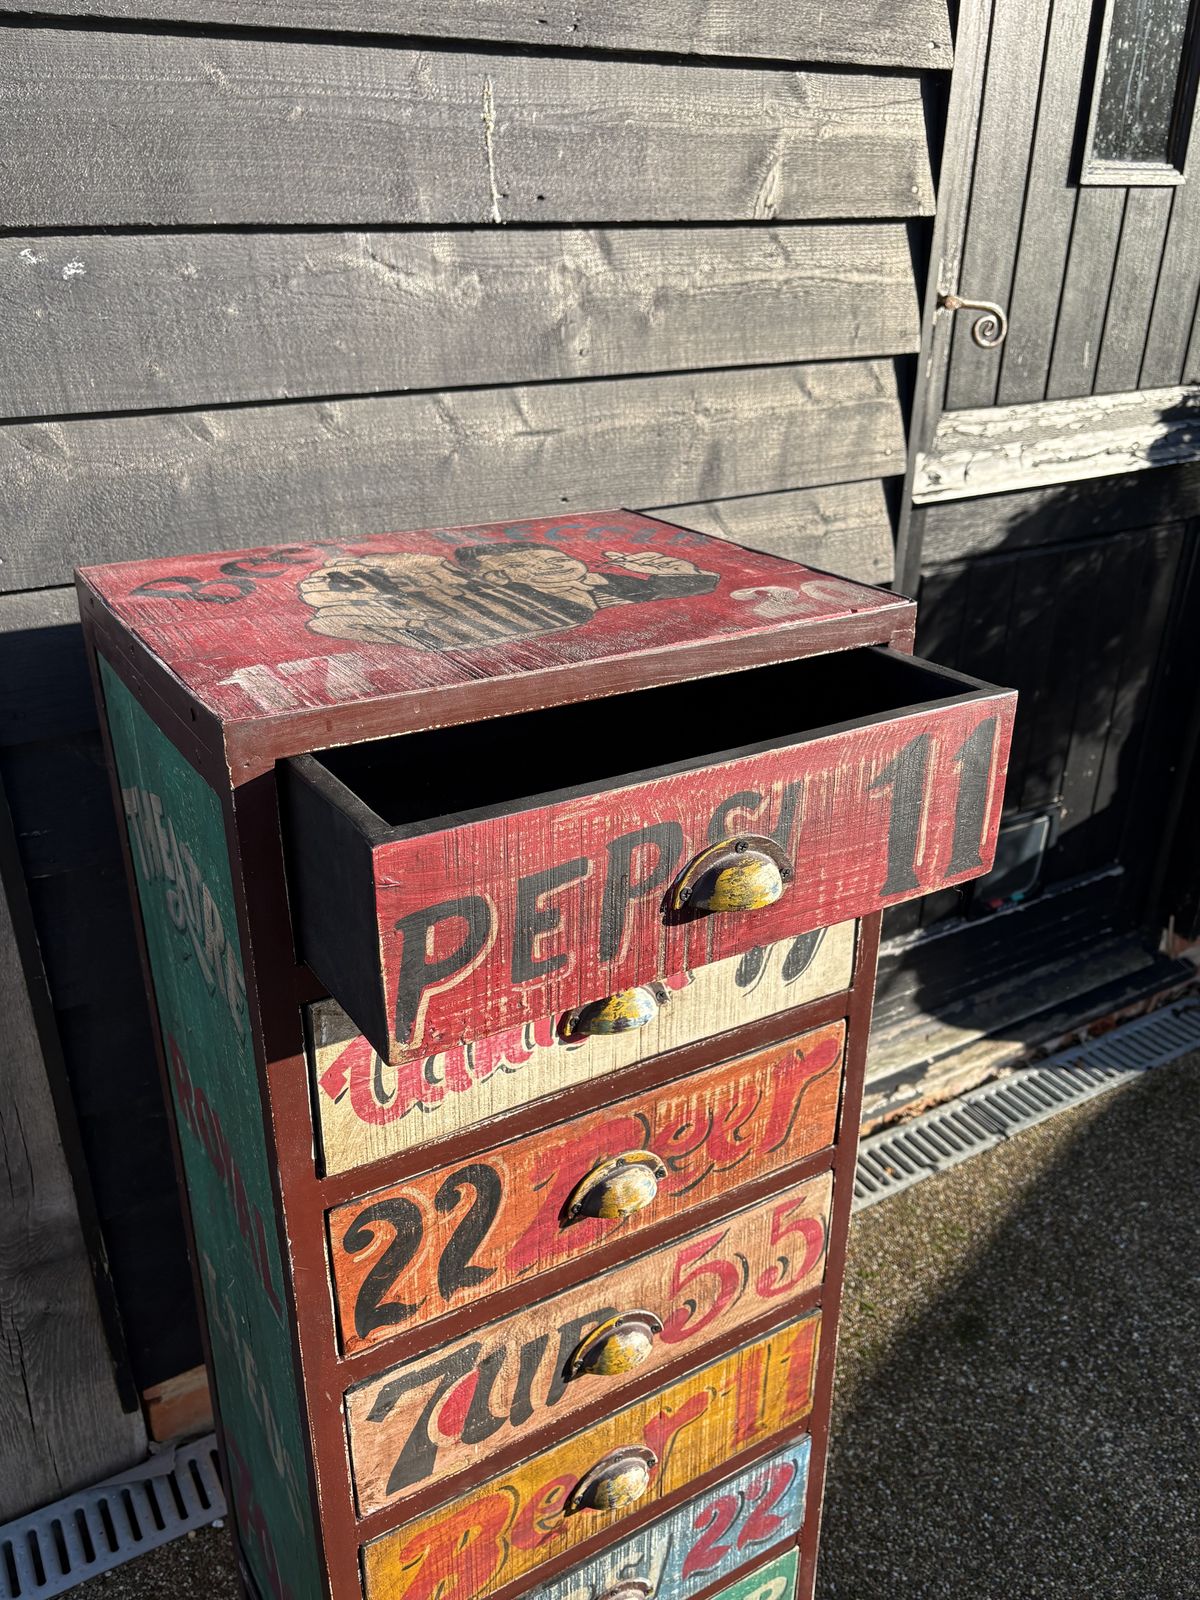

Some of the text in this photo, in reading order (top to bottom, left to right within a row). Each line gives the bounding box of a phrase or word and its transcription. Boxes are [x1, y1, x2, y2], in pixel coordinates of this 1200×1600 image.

[216, 653, 378, 709] 17
[867, 714, 1000, 897] 11
[342, 1162, 510, 1340] 22
[660, 1194, 828, 1345] 55
[722, 1318, 816, 1452] 11
[681, 1457, 799, 1583] 22
